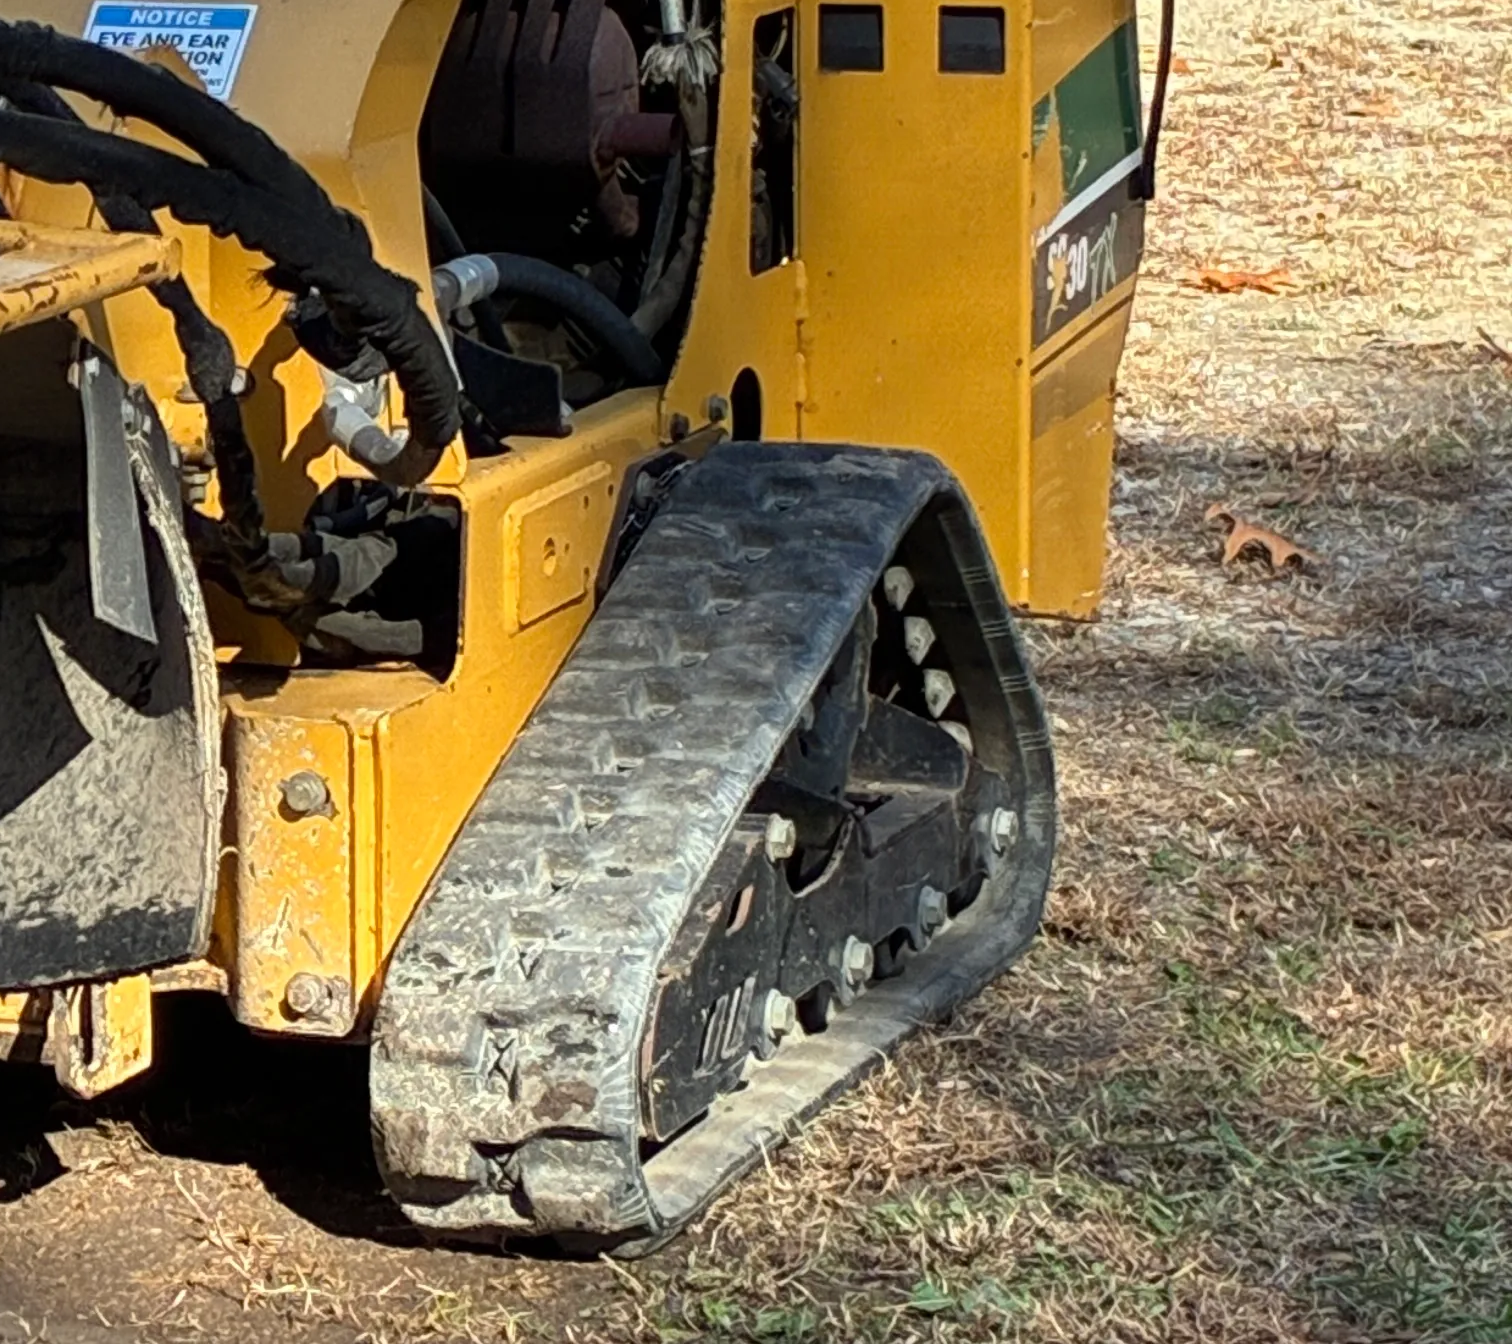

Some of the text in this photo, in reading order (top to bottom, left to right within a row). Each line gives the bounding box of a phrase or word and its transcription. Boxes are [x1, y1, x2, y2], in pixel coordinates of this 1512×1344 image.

[129, 8, 215, 27] NOTICE
[98, 31, 230, 50] EYE AND EAR
